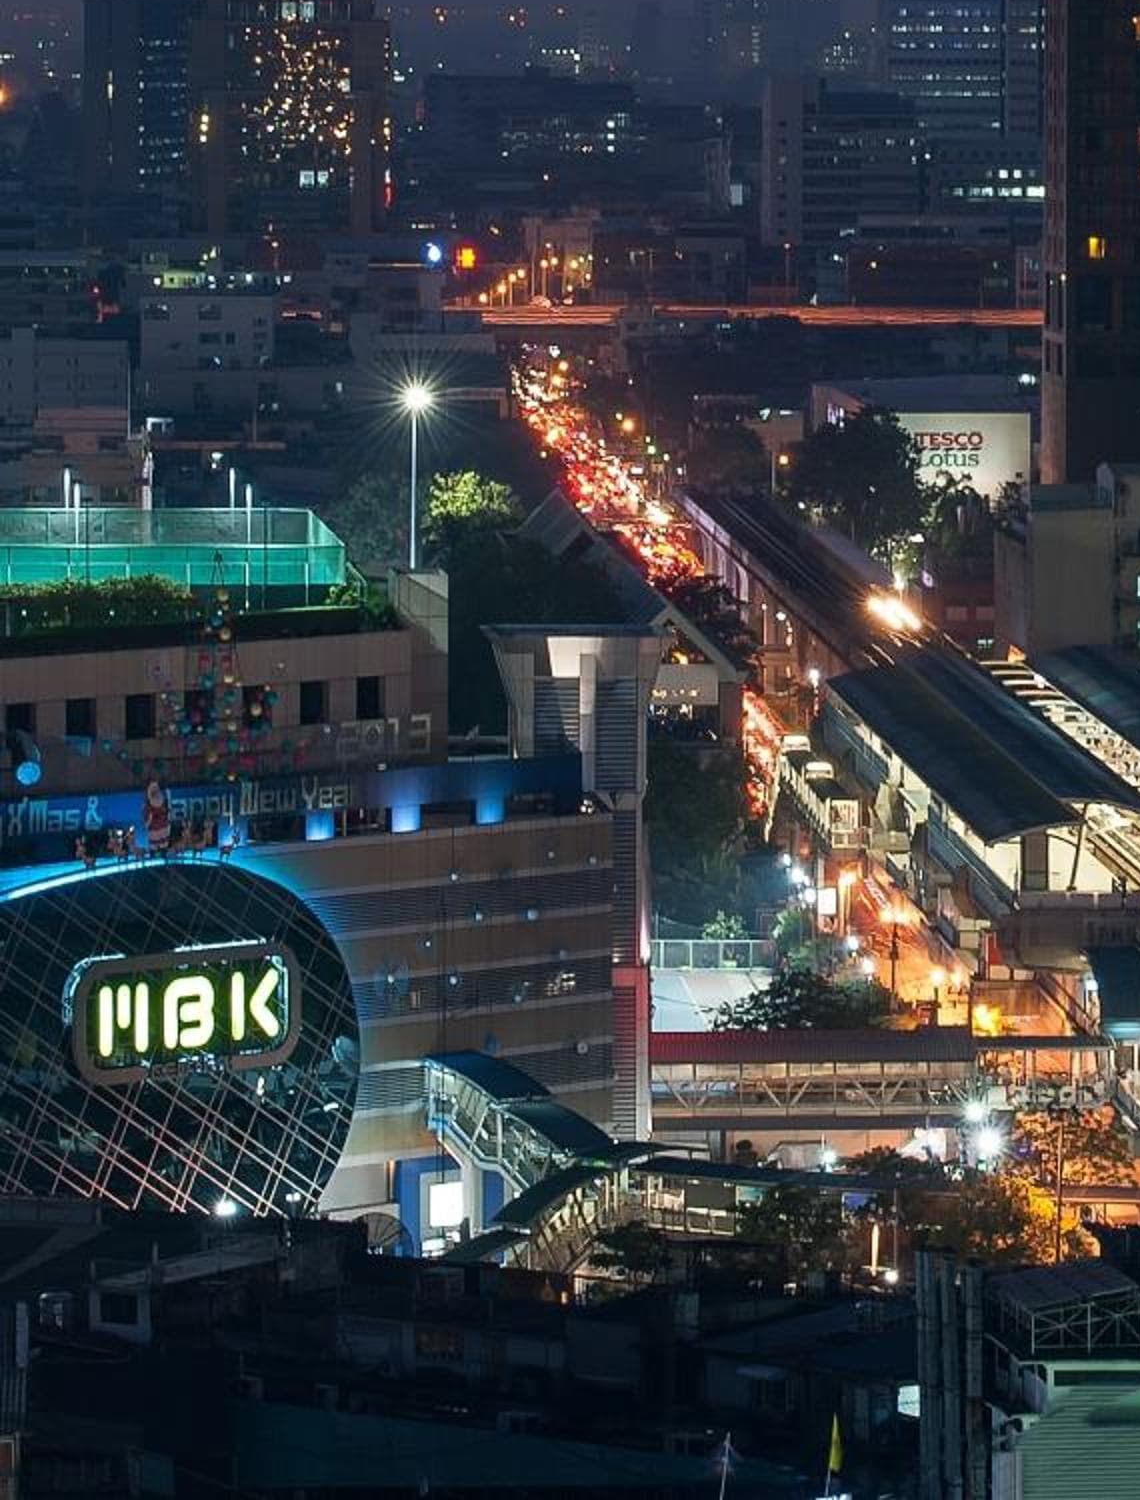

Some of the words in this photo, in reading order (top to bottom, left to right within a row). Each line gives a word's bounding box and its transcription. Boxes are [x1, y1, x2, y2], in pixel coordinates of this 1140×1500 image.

[914, 431, 983, 446] TESCO
[239, 780, 297, 816] New
[98, 967, 280, 1058] MBK
